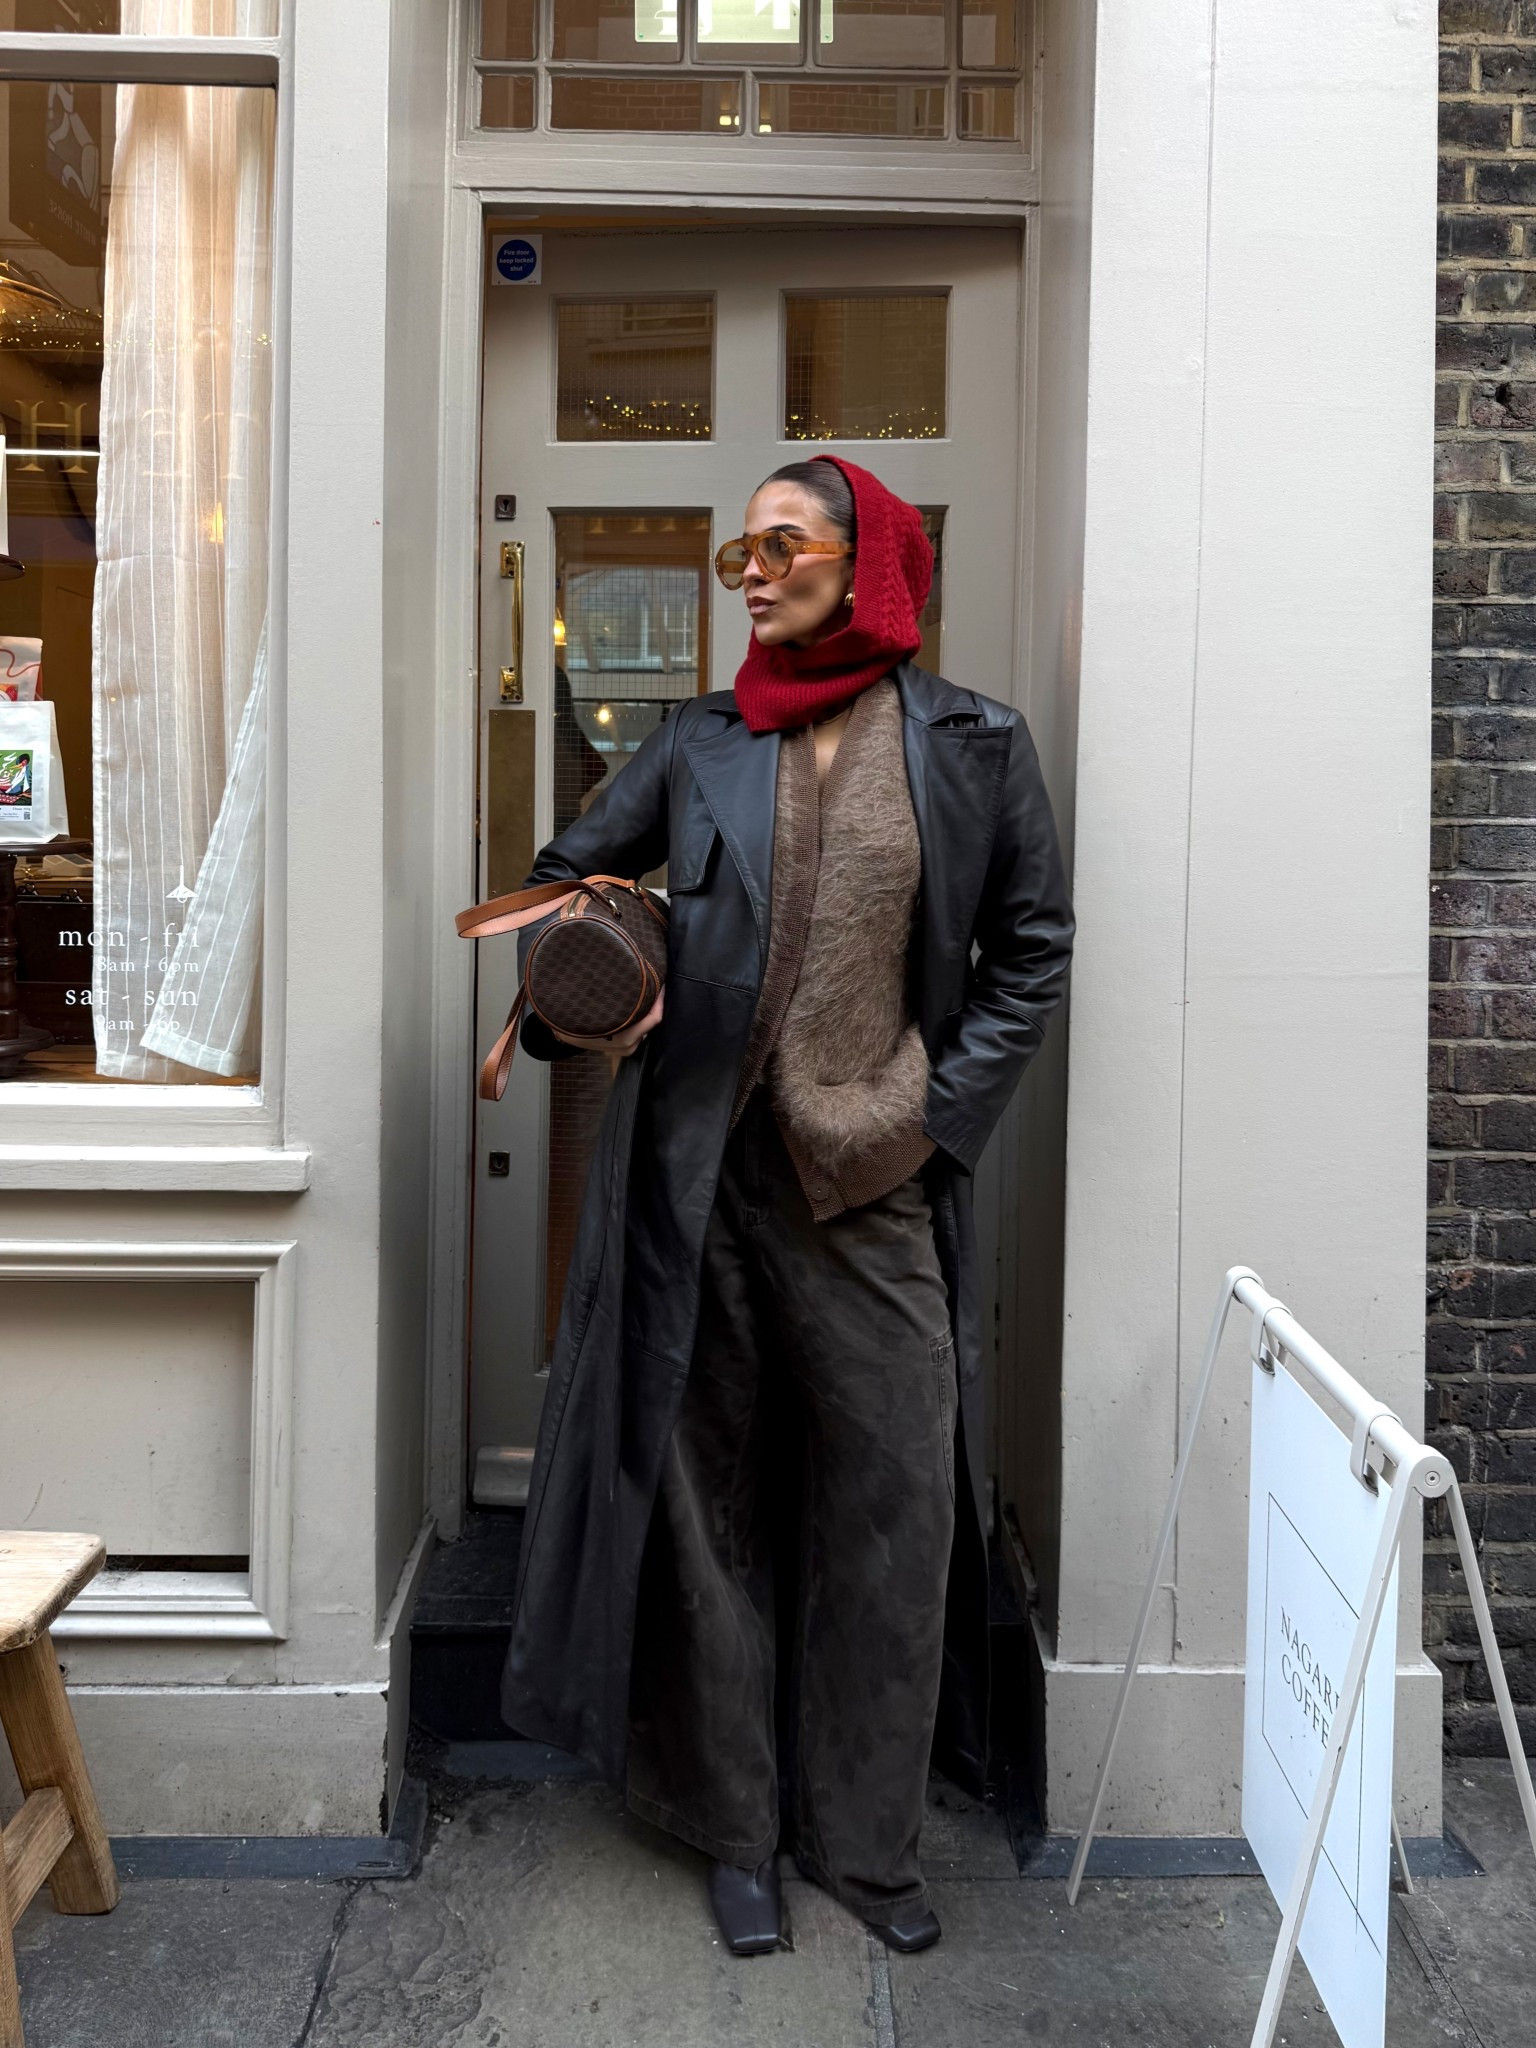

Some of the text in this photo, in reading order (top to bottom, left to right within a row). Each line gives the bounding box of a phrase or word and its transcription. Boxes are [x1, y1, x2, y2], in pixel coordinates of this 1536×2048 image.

[58, 930, 126, 947] mon
[162, 922, 200, 948] fri
[97, 955, 136, 972] 8am
[158, 956, 199, 977] 6pm
[65, 987, 109, 1005] sat
[144, 989, 199, 1006] sun
[1281, 1653, 1330, 1749] COFFE
